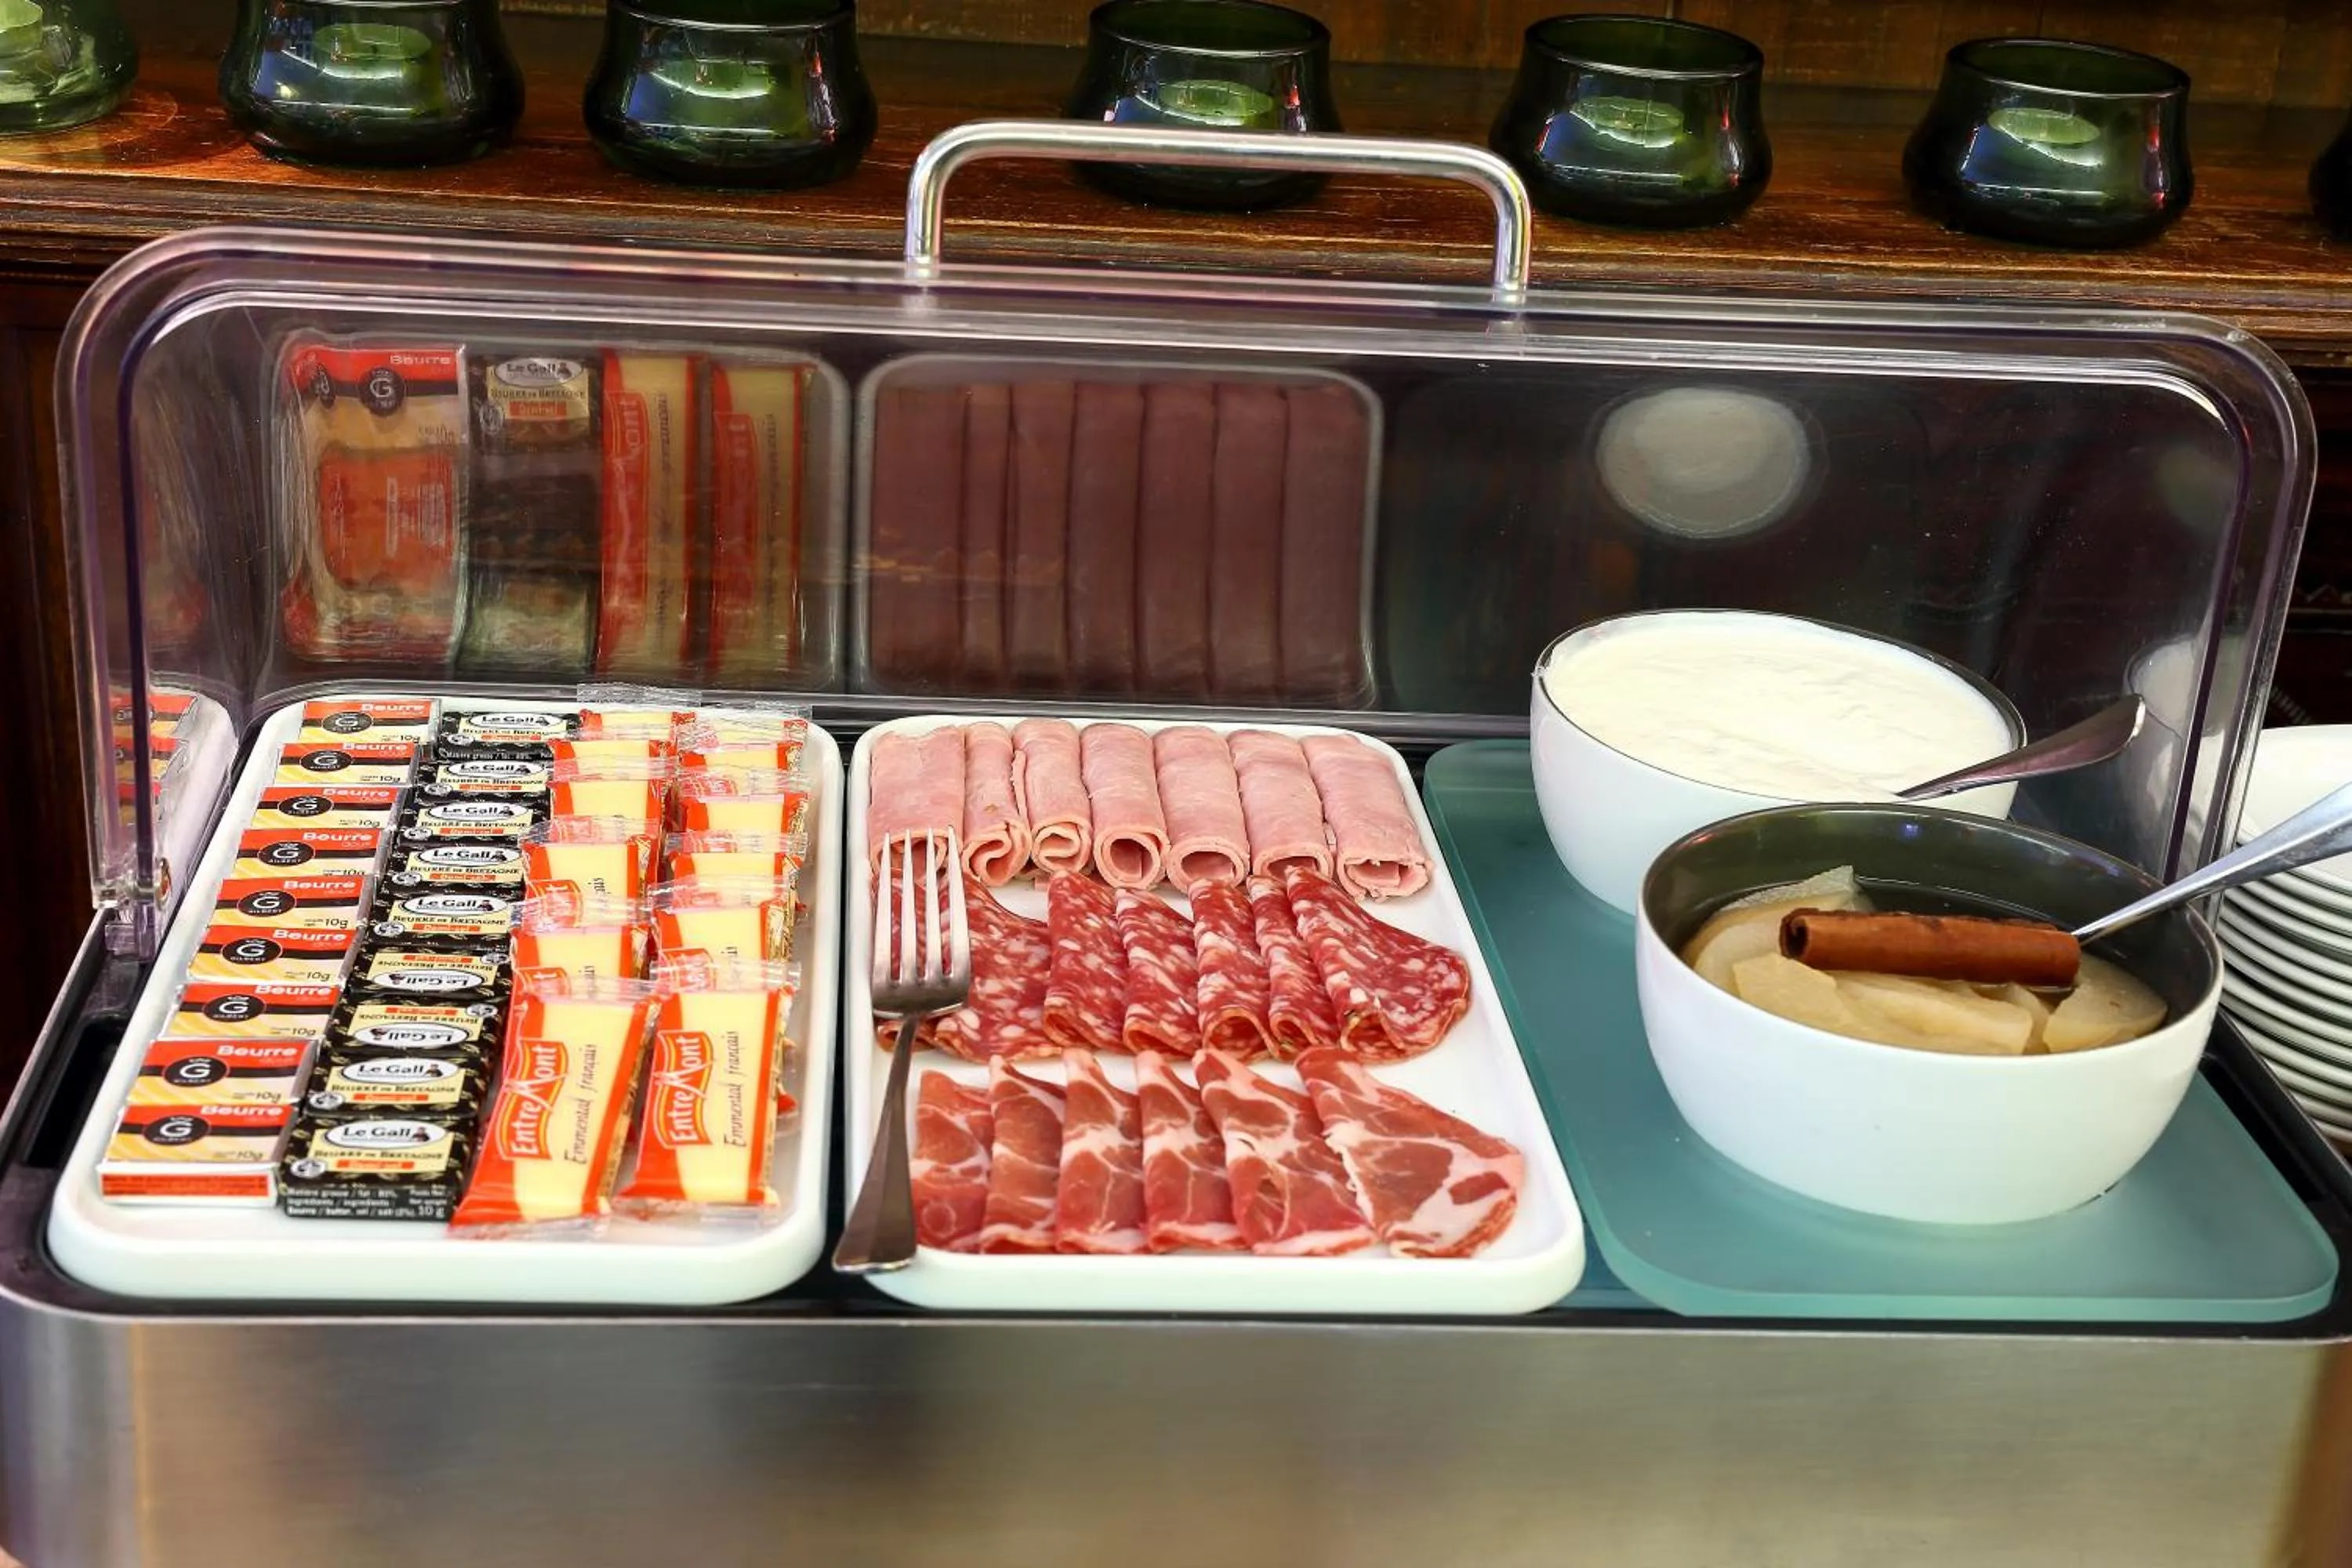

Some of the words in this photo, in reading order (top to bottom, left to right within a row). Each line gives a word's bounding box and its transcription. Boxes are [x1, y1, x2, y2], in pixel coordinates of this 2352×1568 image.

[322, 788, 390, 797] Beurre
[302, 832, 372, 841] Beurre
[283, 880, 356, 889] Beurre
[325, 918, 348, 928] 10g
[272, 929, 347, 941] Beurre
[307, 971, 331, 982] 10g
[254, 985, 332, 996] Beurre
[388, 1033, 426, 1041] Gall
[216, 1045, 298, 1057] Beurre
[358, 1065, 382, 1073] Le
[386, 1065, 423, 1074] Gall
[200, 1105, 283, 1116] Beurre
[343, 1127, 367, 1136] Le
[371, 1127, 411, 1137] Gall
